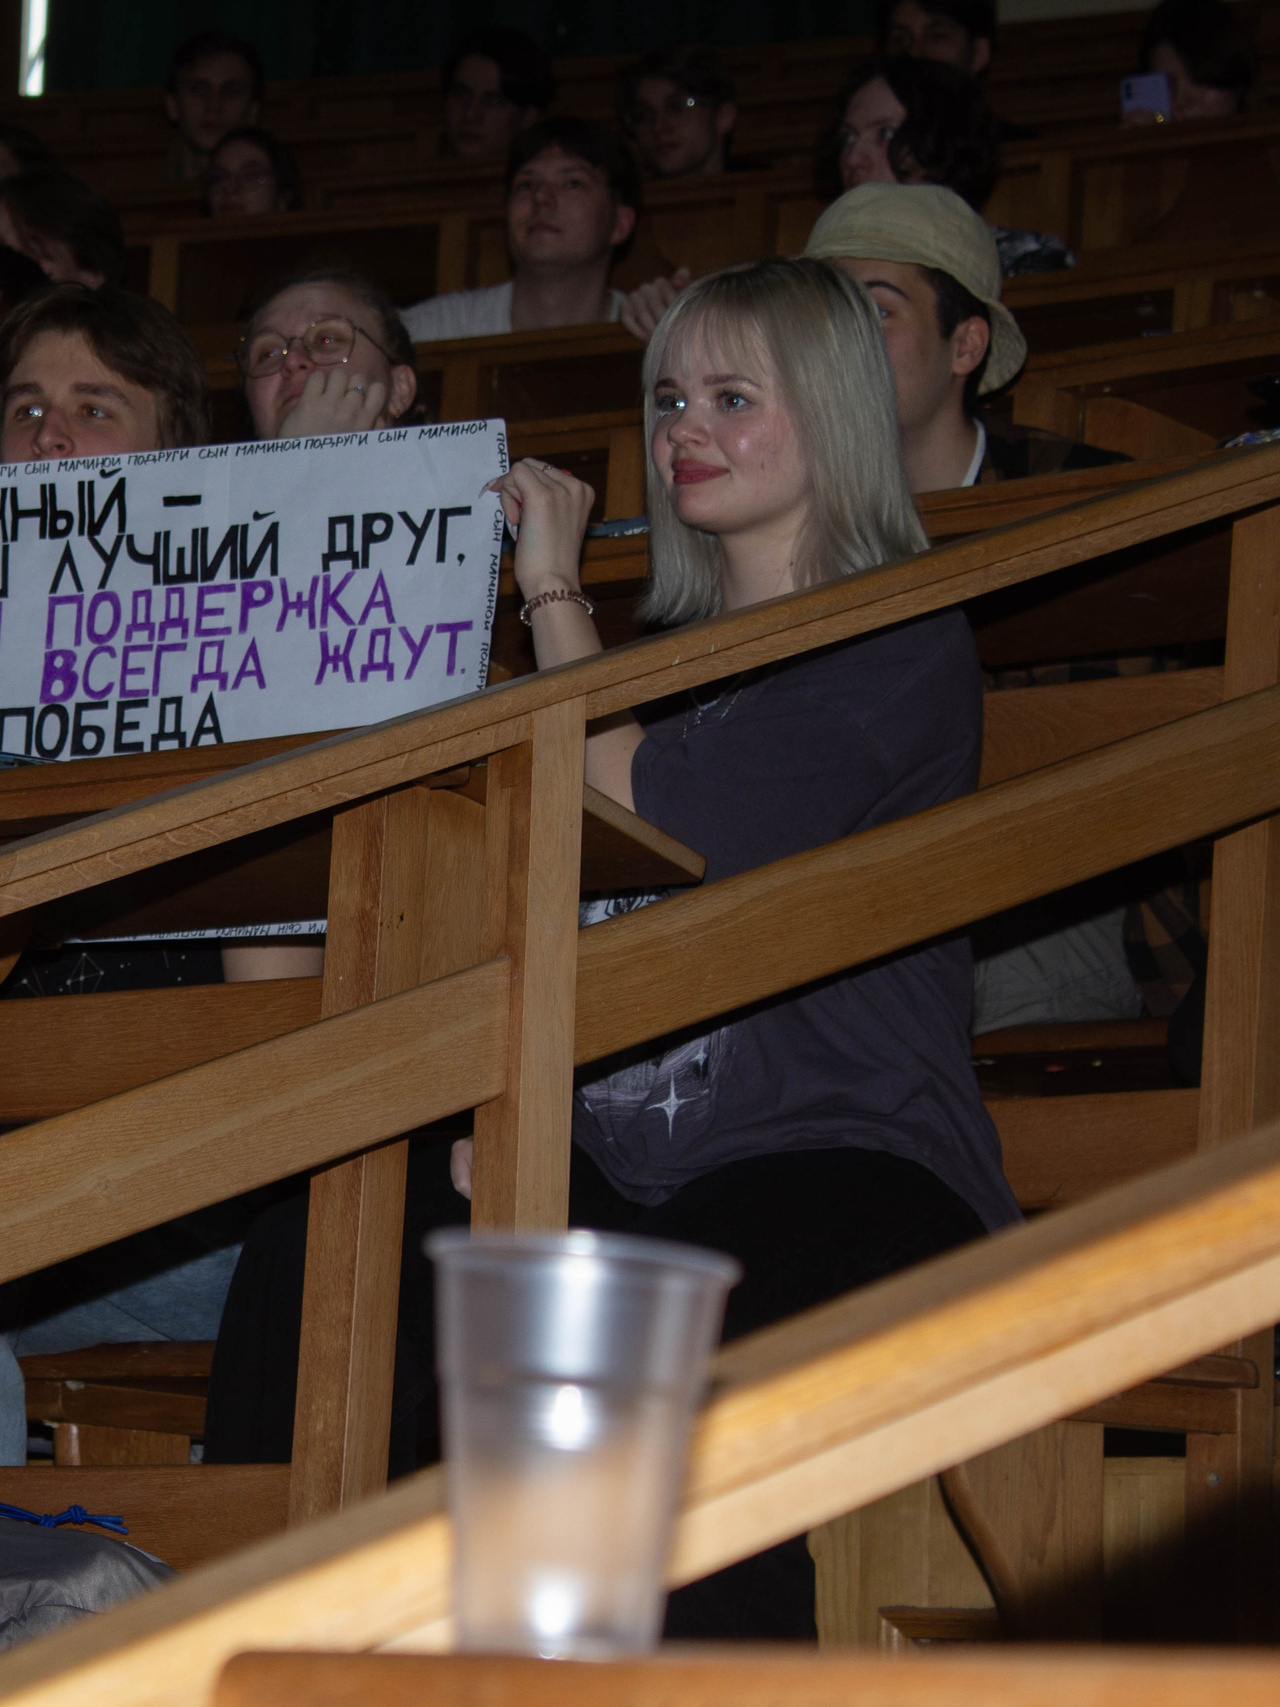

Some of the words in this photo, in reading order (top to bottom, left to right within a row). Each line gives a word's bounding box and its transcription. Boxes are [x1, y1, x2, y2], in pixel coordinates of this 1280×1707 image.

[24, 463, 50, 475] СЫН
[128, 449, 190, 466] ПОДРУГИ
[198, 446, 229, 460] СЫН
[235, 438, 301, 457] МАМИНОЙ
[304, 433, 369, 450] ПОДРУГИ
[378, 430, 408, 443] СЫН
[419, 421, 487, 439] МАМИНОЙ
[49, 511, 280, 595] ЛУЧШИЙ
[321, 506, 473, 573] ДРУГ,
[492, 509, 503, 542] СЫН
[44, 569, 396, 650] ПОДДЕРЖКА
[39, 637, 267, 705] ВСЕГДА
[314, 621, 474, 686] ЖДУТ.
